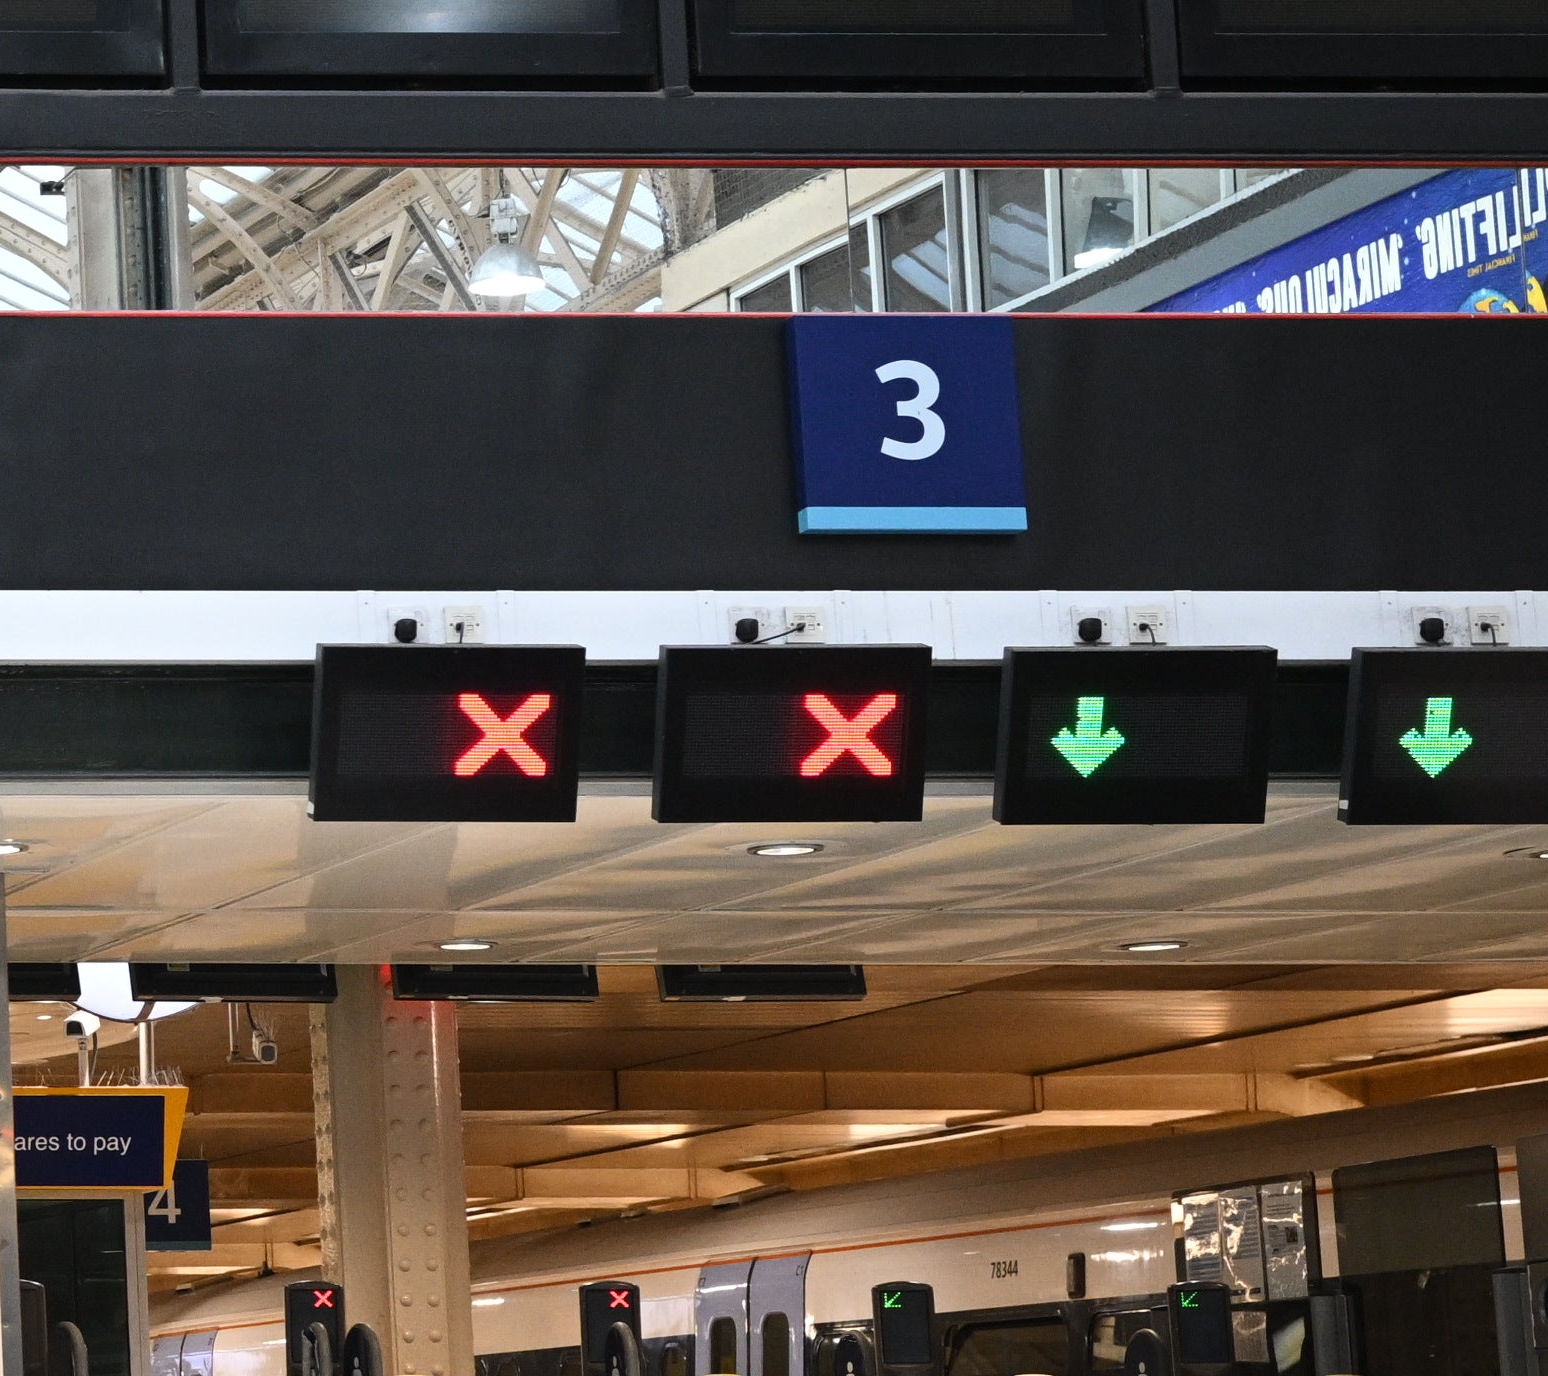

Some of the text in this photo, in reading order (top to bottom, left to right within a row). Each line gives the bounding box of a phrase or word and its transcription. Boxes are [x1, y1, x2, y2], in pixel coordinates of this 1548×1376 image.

[874, 359, 946, 461] 3
[14, 1132, 132, 1156] ares to pay
[147, 1180, 182, 1224] 4
[990, 1259, 1019, 1279] 78344
